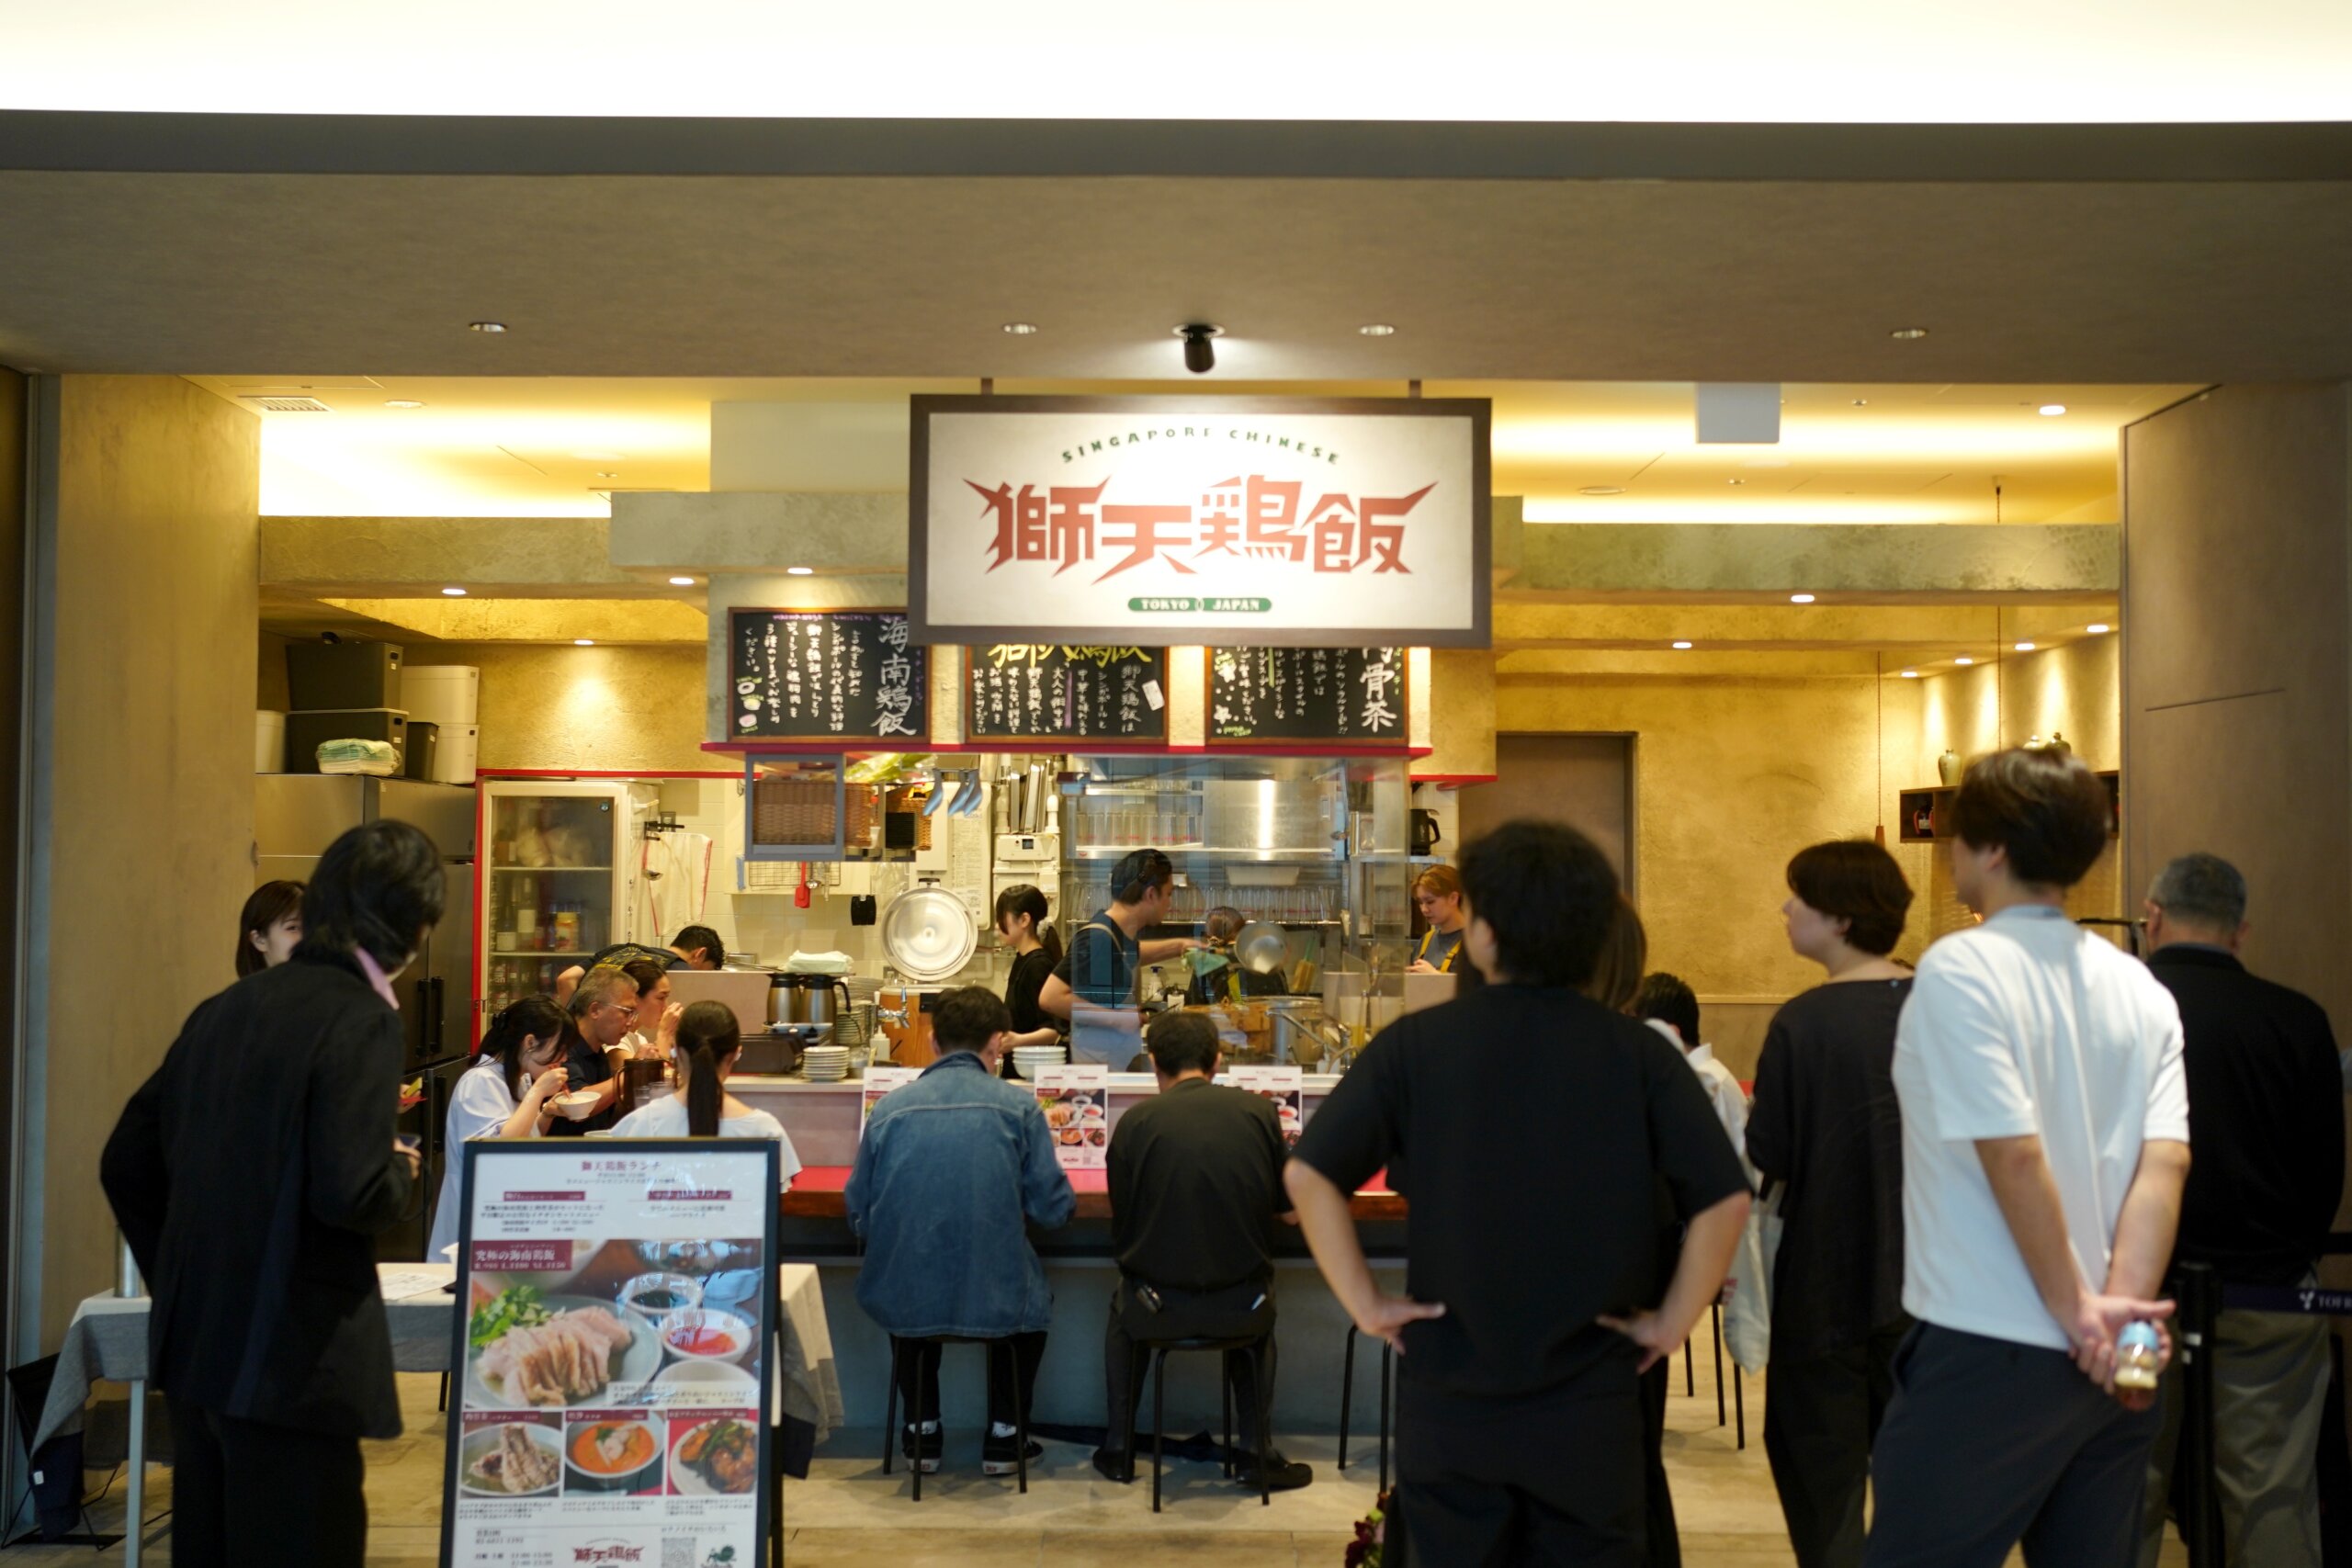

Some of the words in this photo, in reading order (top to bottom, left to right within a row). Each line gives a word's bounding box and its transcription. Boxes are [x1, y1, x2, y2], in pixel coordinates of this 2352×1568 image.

[1062, 427, 1210, 462] SINGAPORE
[1229, 428, 1339, 464] CHINESE
[962, 474, 1440, 585] 獅天鶏飯
[1140, 598, 1190, 611] TOKYO
[1212, 598, 1261, 611] JAPAN
[870, 619, 917, 737] 海南鶏飯
